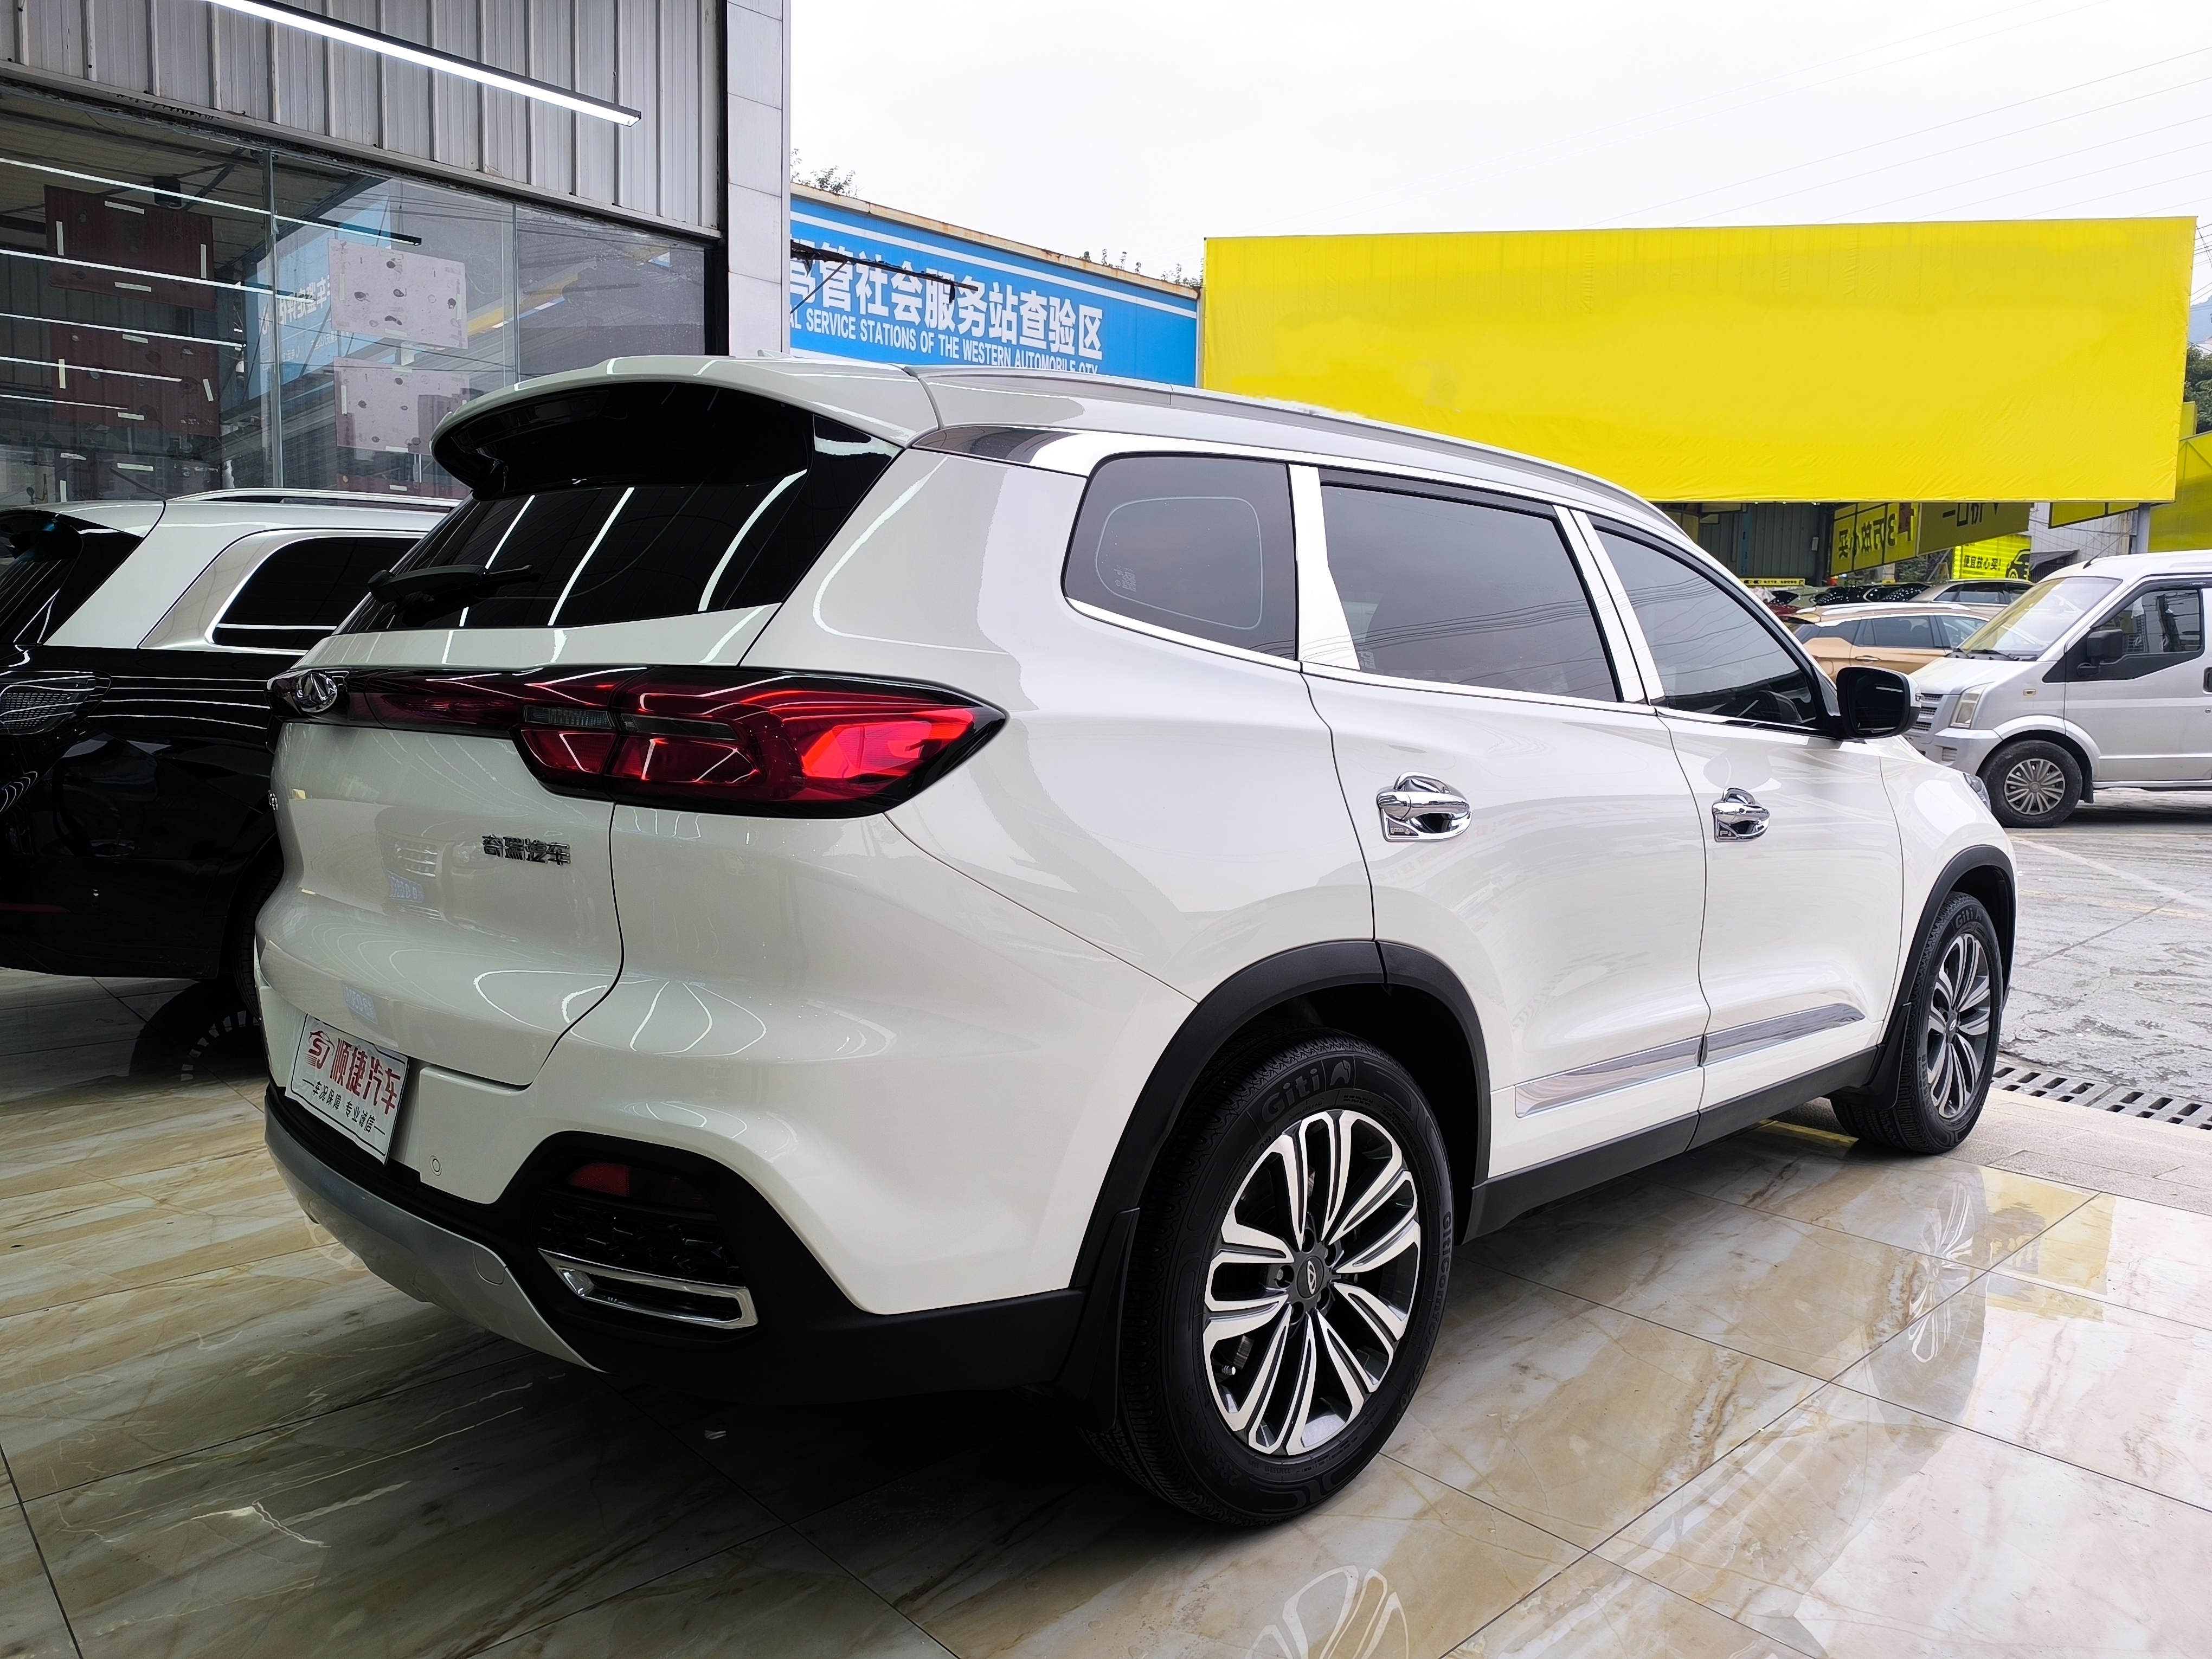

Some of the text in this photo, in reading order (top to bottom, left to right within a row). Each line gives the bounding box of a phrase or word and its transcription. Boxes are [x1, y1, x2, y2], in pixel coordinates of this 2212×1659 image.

[806, 307, 856, 340] SERVICE
[860, 319, 916, 351] STATIONS
[920, 331, 934, 353] OF
[938, 334, 959, 359] THE
[962, 338, 1011, 367] WESTERN
[482, 834, 571, 866] 奇瑞汽车
[330, 1038, 401, 1115] 顺捷汽车
[1261, 1068, 1322, 1122] Giti
[312, 1081, 376, 1133] 车况保障 专业诚信
